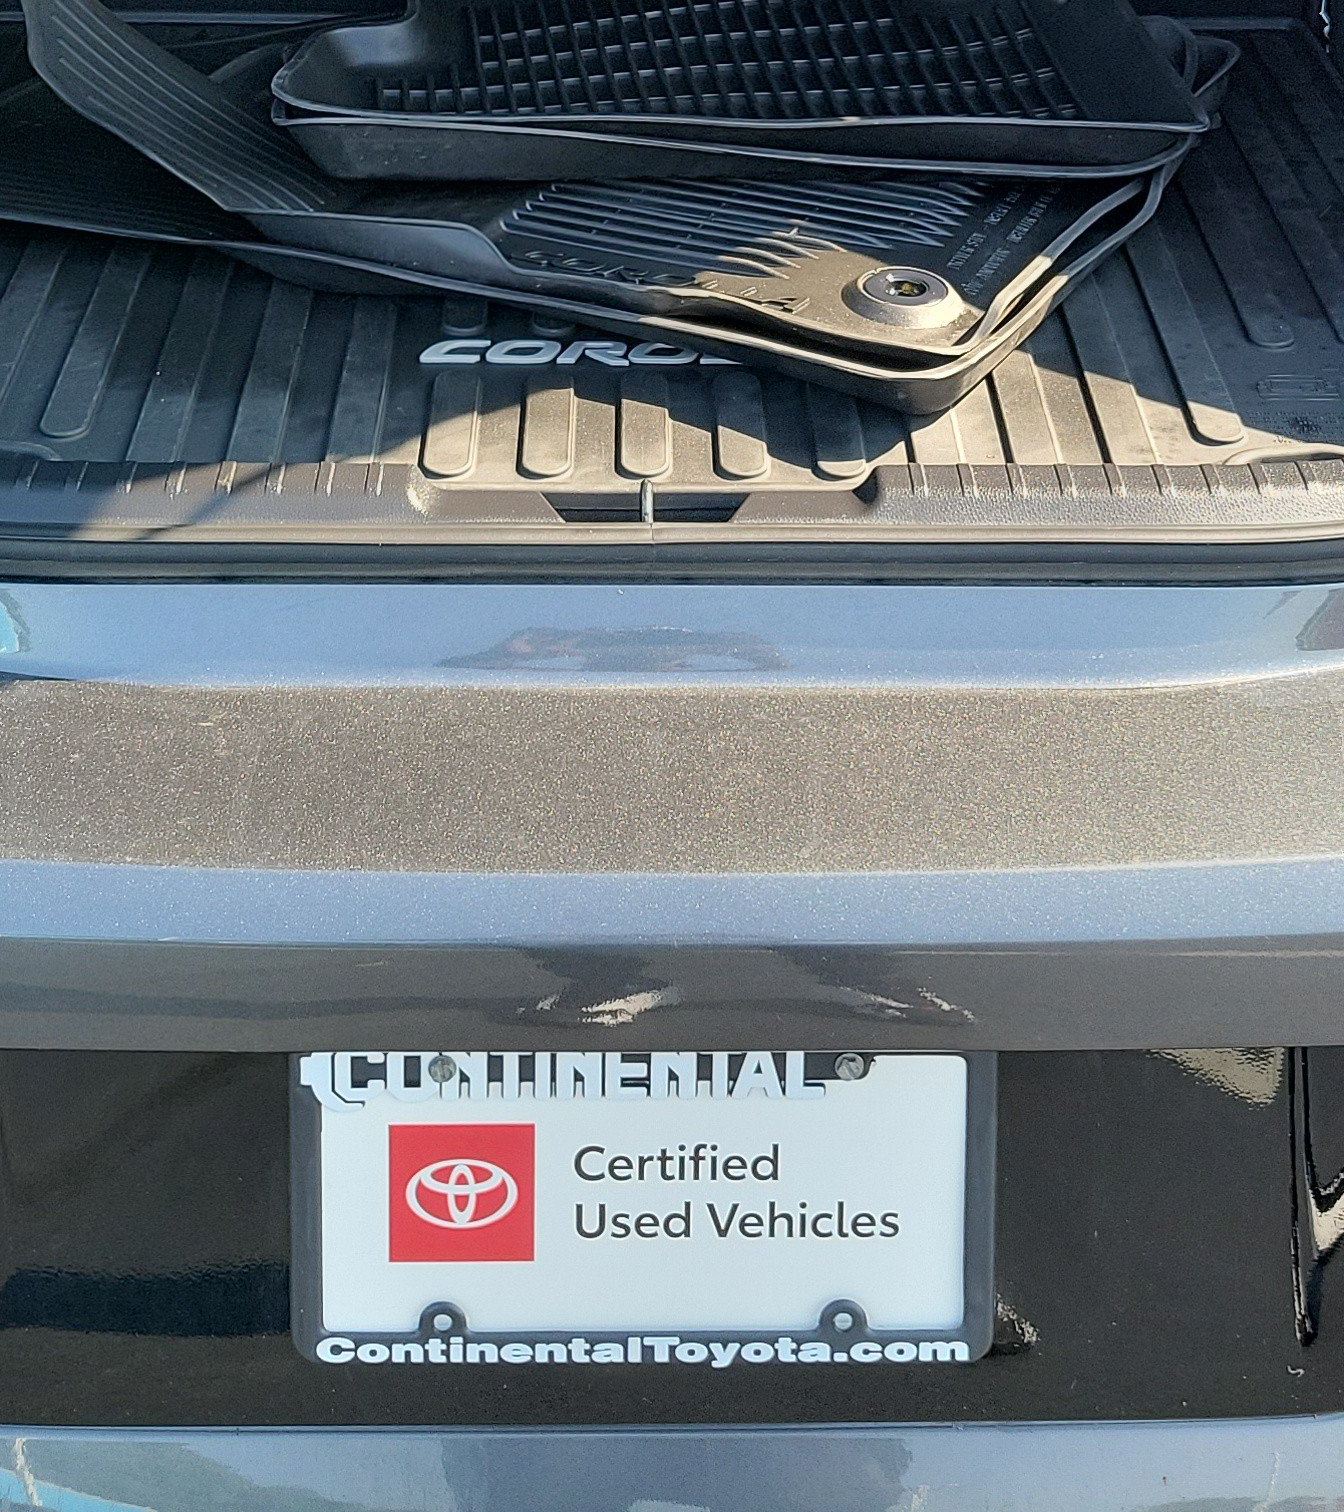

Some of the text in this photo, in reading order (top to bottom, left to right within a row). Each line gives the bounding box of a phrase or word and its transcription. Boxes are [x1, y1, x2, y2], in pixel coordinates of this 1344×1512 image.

[334, 1051, 825, 1102] CONTINENTAL
[574, 1144, 781, 1182] Certified
[575, 1201, 901, 1240] Used Vehicles
[315, 1335, 970, 1370] ContinentalToyota.com
